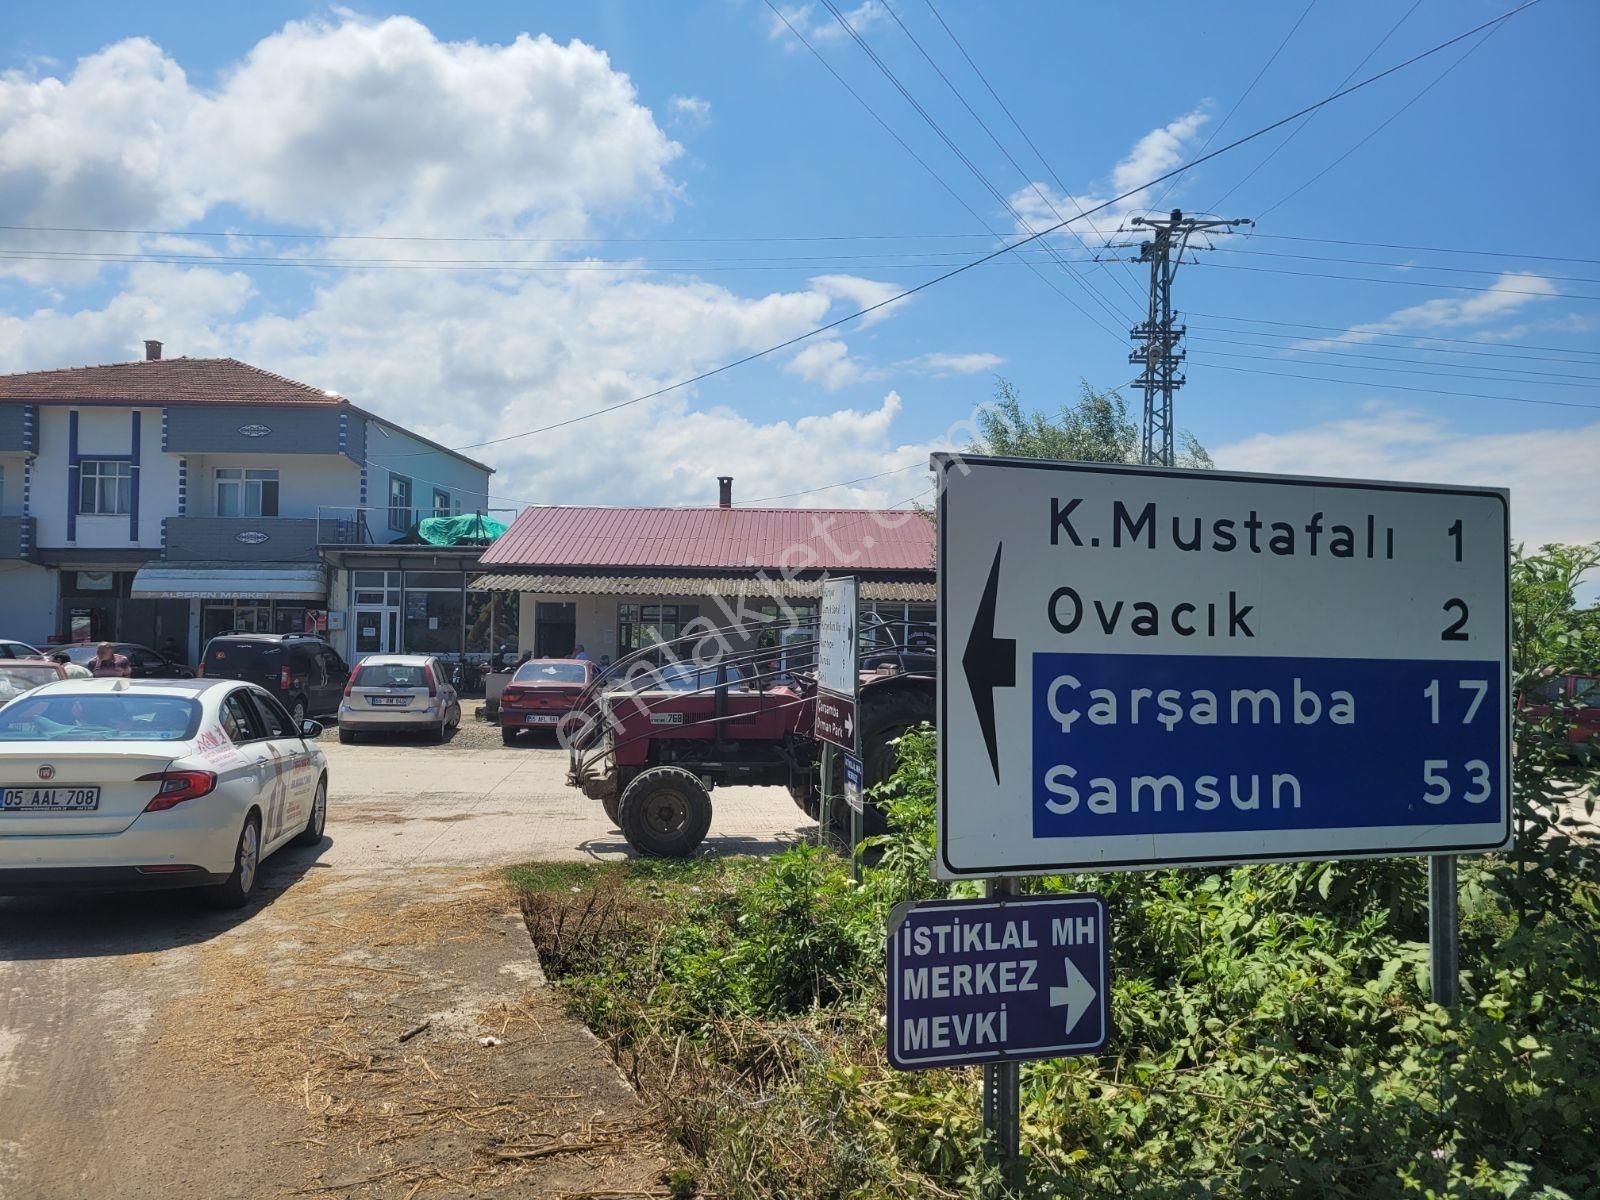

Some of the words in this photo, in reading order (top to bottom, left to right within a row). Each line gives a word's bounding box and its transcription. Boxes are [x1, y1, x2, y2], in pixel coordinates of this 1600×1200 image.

[1050, 497, 1394, 559] K.Mustafalı
[1448, 520, 1463, 562] 1
[219, 591, 271, 600] MARKET
[1048, 586, 1255, 637] Ovacık
[1441, 598, 1469, 641] 2
[667, 713, 682, 723] 768
[1046, 674, 1356, 732] Çarşamba
[1423, 679, 1489, 724] 17
[832, 722, 843, 738] Park
[5, 790, 23, 805] 05
[32, 790, 60, 805] AAL
[66, 790, 95, 805] 708
[1044, 764, 1302, 815] Samsun
[1422, 759, 1492, 805] 53
[903, 917, 1038, 957] İSTİKLAL
[1051, 916, 1095, 946] MH
[903, 959, 1039, 1001] MERKEZ
[903, 1002, 1008, 1051] MEVKİ
